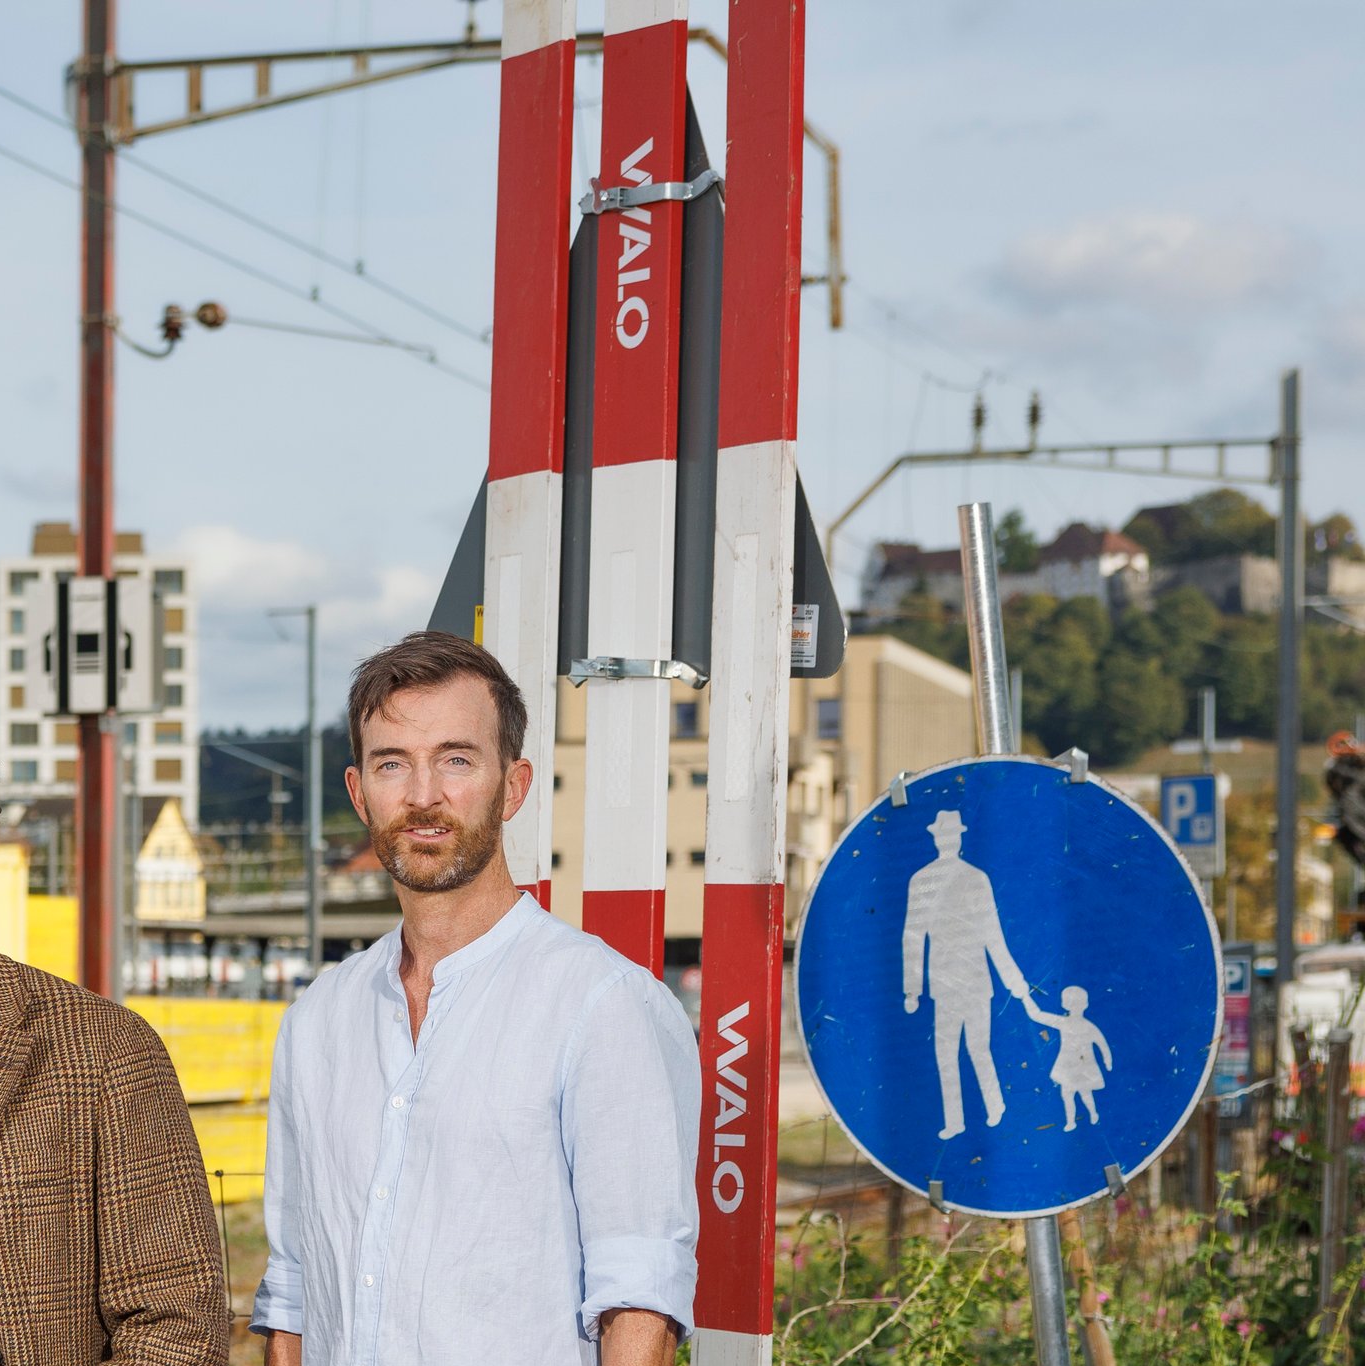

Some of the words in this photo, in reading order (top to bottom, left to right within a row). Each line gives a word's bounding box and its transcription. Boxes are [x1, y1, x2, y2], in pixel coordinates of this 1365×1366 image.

[616, 137, 653, 349] WALO
[1170, 784, 1196, 836] P
[712, 1001, 749, 1213] WALO
